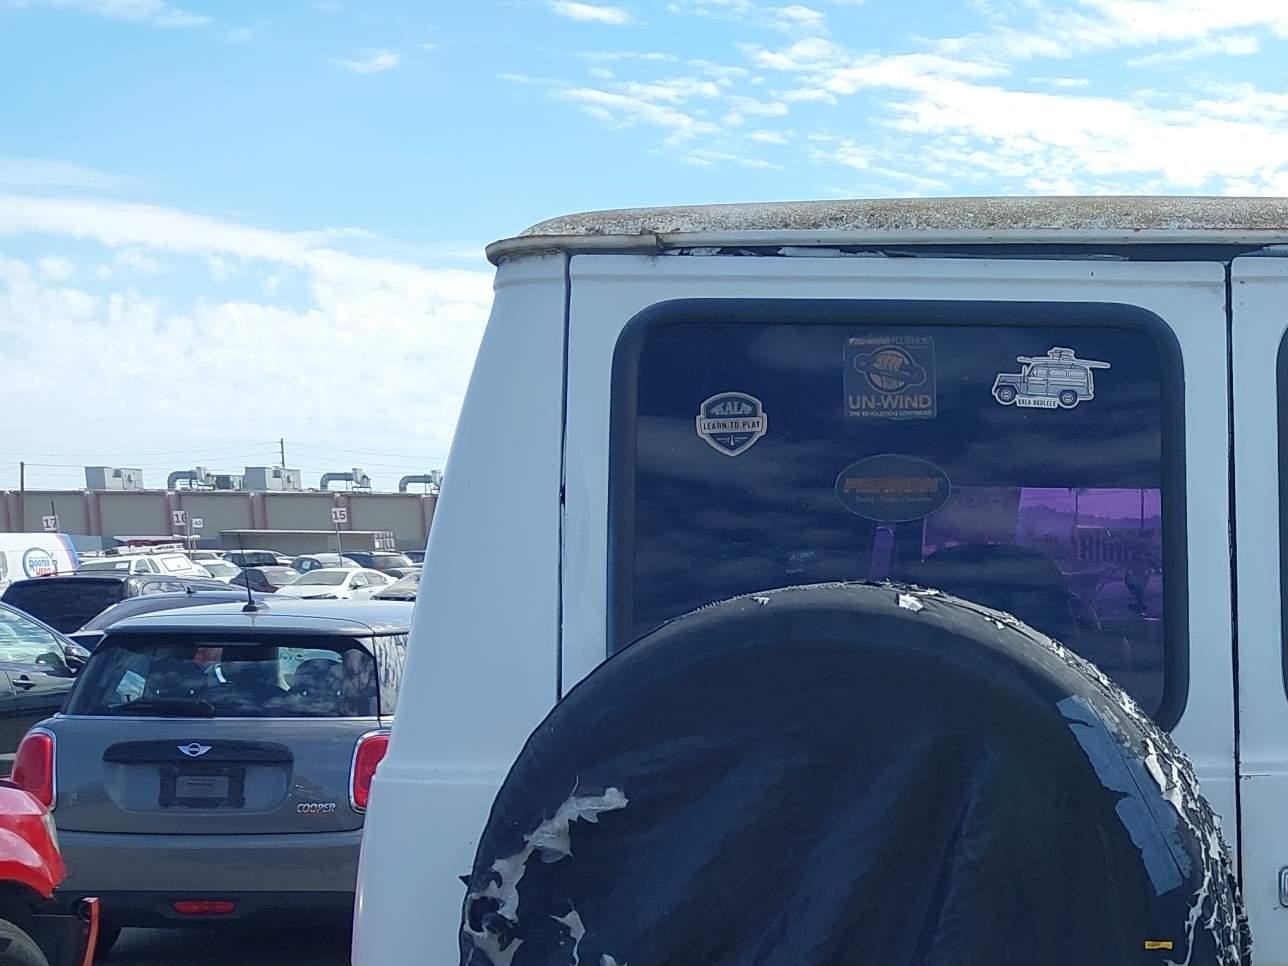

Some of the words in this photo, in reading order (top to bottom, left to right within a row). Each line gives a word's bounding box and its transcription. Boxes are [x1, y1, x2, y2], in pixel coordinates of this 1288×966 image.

[848, 394, 932, 409] UN-WIND
[703, 421, 728, 430] LEARN
[730, 421, 740, 429] TO
[742, 420, 761, 428] PLAY
[332, 510, 347, 521] 15
[43, 518, 57, 530] 17
[297, 803, 336, 813] COOPER
